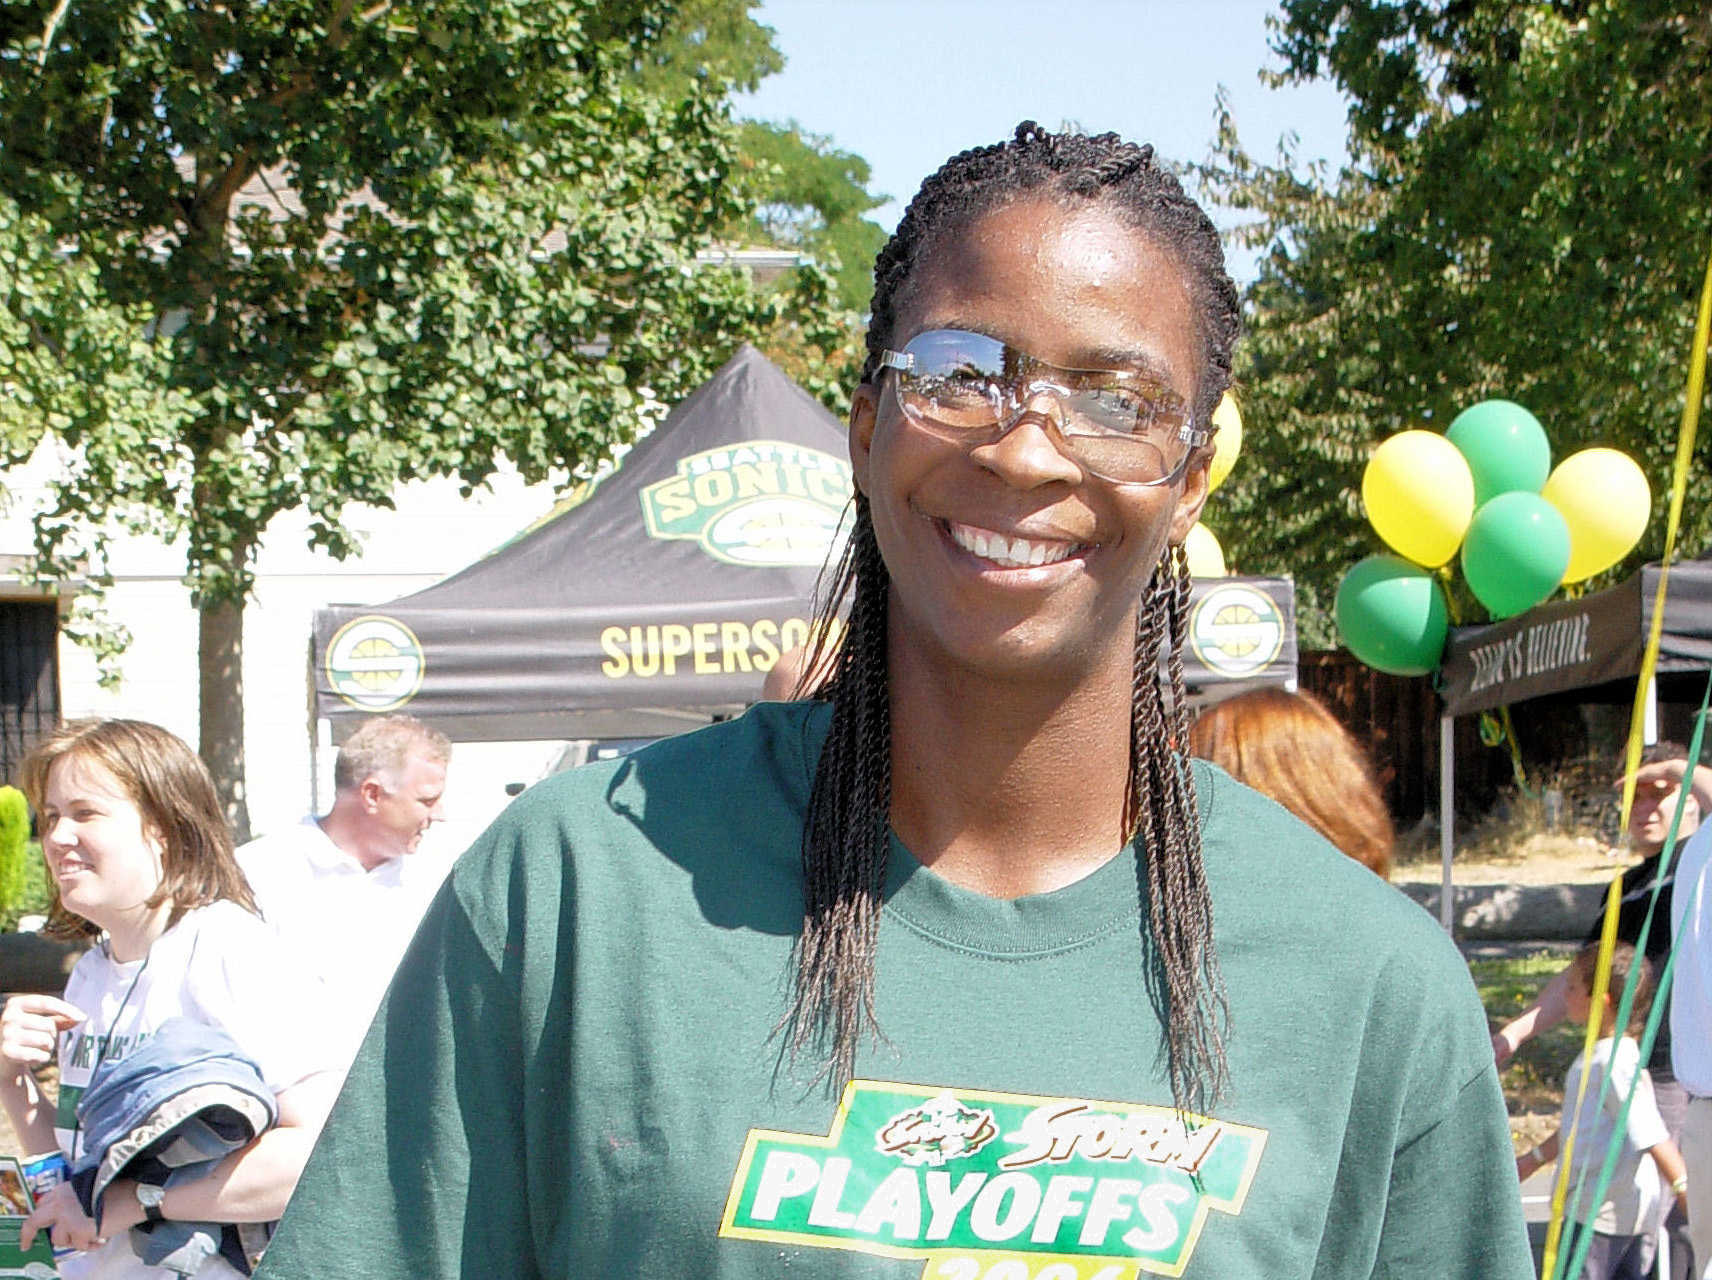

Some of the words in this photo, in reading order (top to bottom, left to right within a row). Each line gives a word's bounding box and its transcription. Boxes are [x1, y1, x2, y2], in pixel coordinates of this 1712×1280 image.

[655, 461, 856, 523] SONIC
[600, 617, 841, 679] SUPERSO
[750, 1151, 1191, 1251] PLAYOFFS
